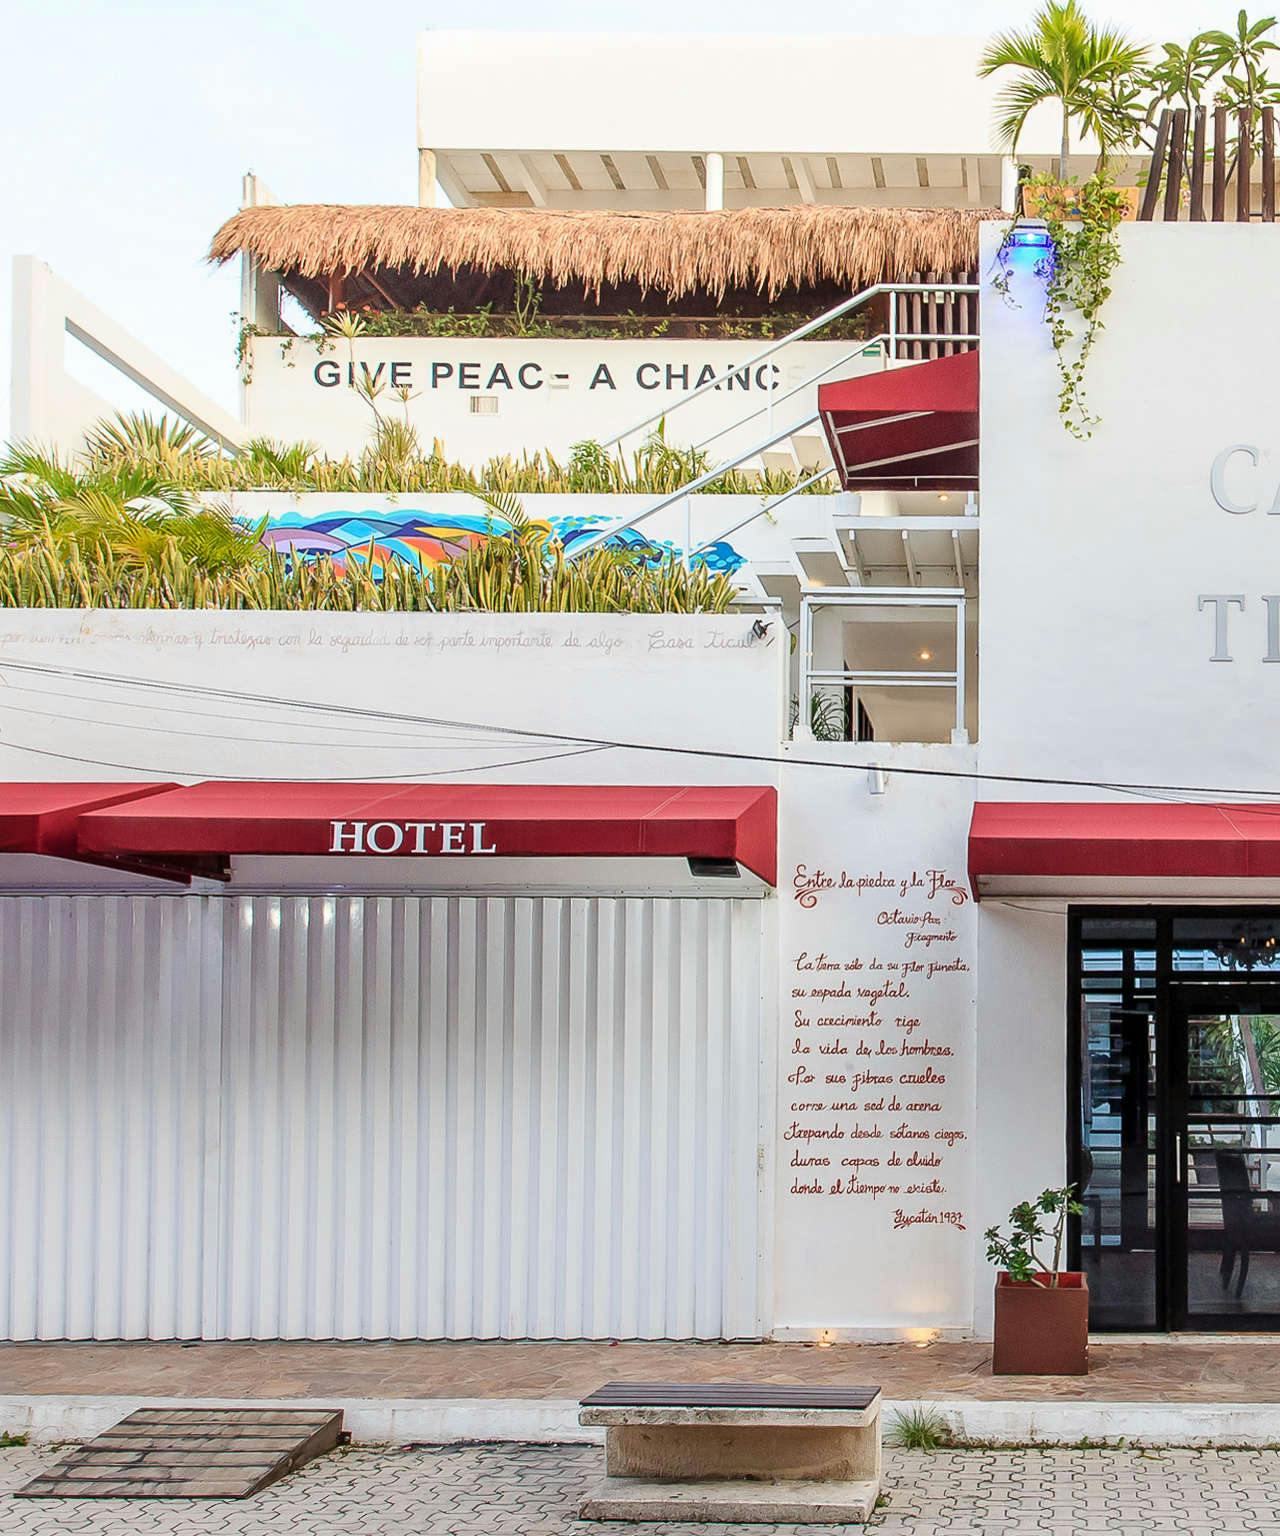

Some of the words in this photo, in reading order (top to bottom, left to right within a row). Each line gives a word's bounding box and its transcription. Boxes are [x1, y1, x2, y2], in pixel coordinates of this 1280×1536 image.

[314, 360, 413, 388] GIVE
[590, 363, 617, 390] A
[636, 363, 806, 391] CHANC
[561, 630, 582, 647] de
[585, 630, 624, 655] algo
[329, 821, 497, 853] HOTEL
[793, 864, 835, 889] Entre
[837, 871, 854, 889] la
[856, 871, 896, 896] piedra
[899, 879, 910, 897] y
[911, 872, 925, 888] la
[877, 909, 919, 925] Octavio
[794, 952, 814, 971] La
[869, 957, 883, 970] da
[887, 962, 899, 971] su
[792, 987, 807, 998] su
[809, 981, 851, 1002] espada
[794, 1010, 810, 1028] Su
[817, 1011, 883, 1027] crecimiento
[895, 1016, 921, 1035] rige
[792, 1038, 810, 1054] la
[819, 1039, 848, 1054] vida
[874, 1040, 898, 1055] los
[788, 1065, 816, 1086] Por
[825, 1074, 847, 1084] sus
[899, 1067, 946, 1084] crueles
[791, 1102, 827, 1112] corre
[830, 1102, 858, 1111] una
[863, 1097, 884, 1111] sed
[887, 1095, 901, 1111] de
[906, 1103, 942, 1112] arena
[850, 1123, 884, 1139] desde
[790, 1149, 831, 1167] duras
[841, 1157, 880, 1173] capas
[887, 1151, 902, 1166] de
[906, 1151, 943, 1167] olvido
[790, 1177, 824, 1194] donde
[828, 1179, 845, 1196] el
[846, 1174, 886, 1200] tiempo
[888, 1185, 900, 1194] no
[940, 1211, 963, 1225] 1937
